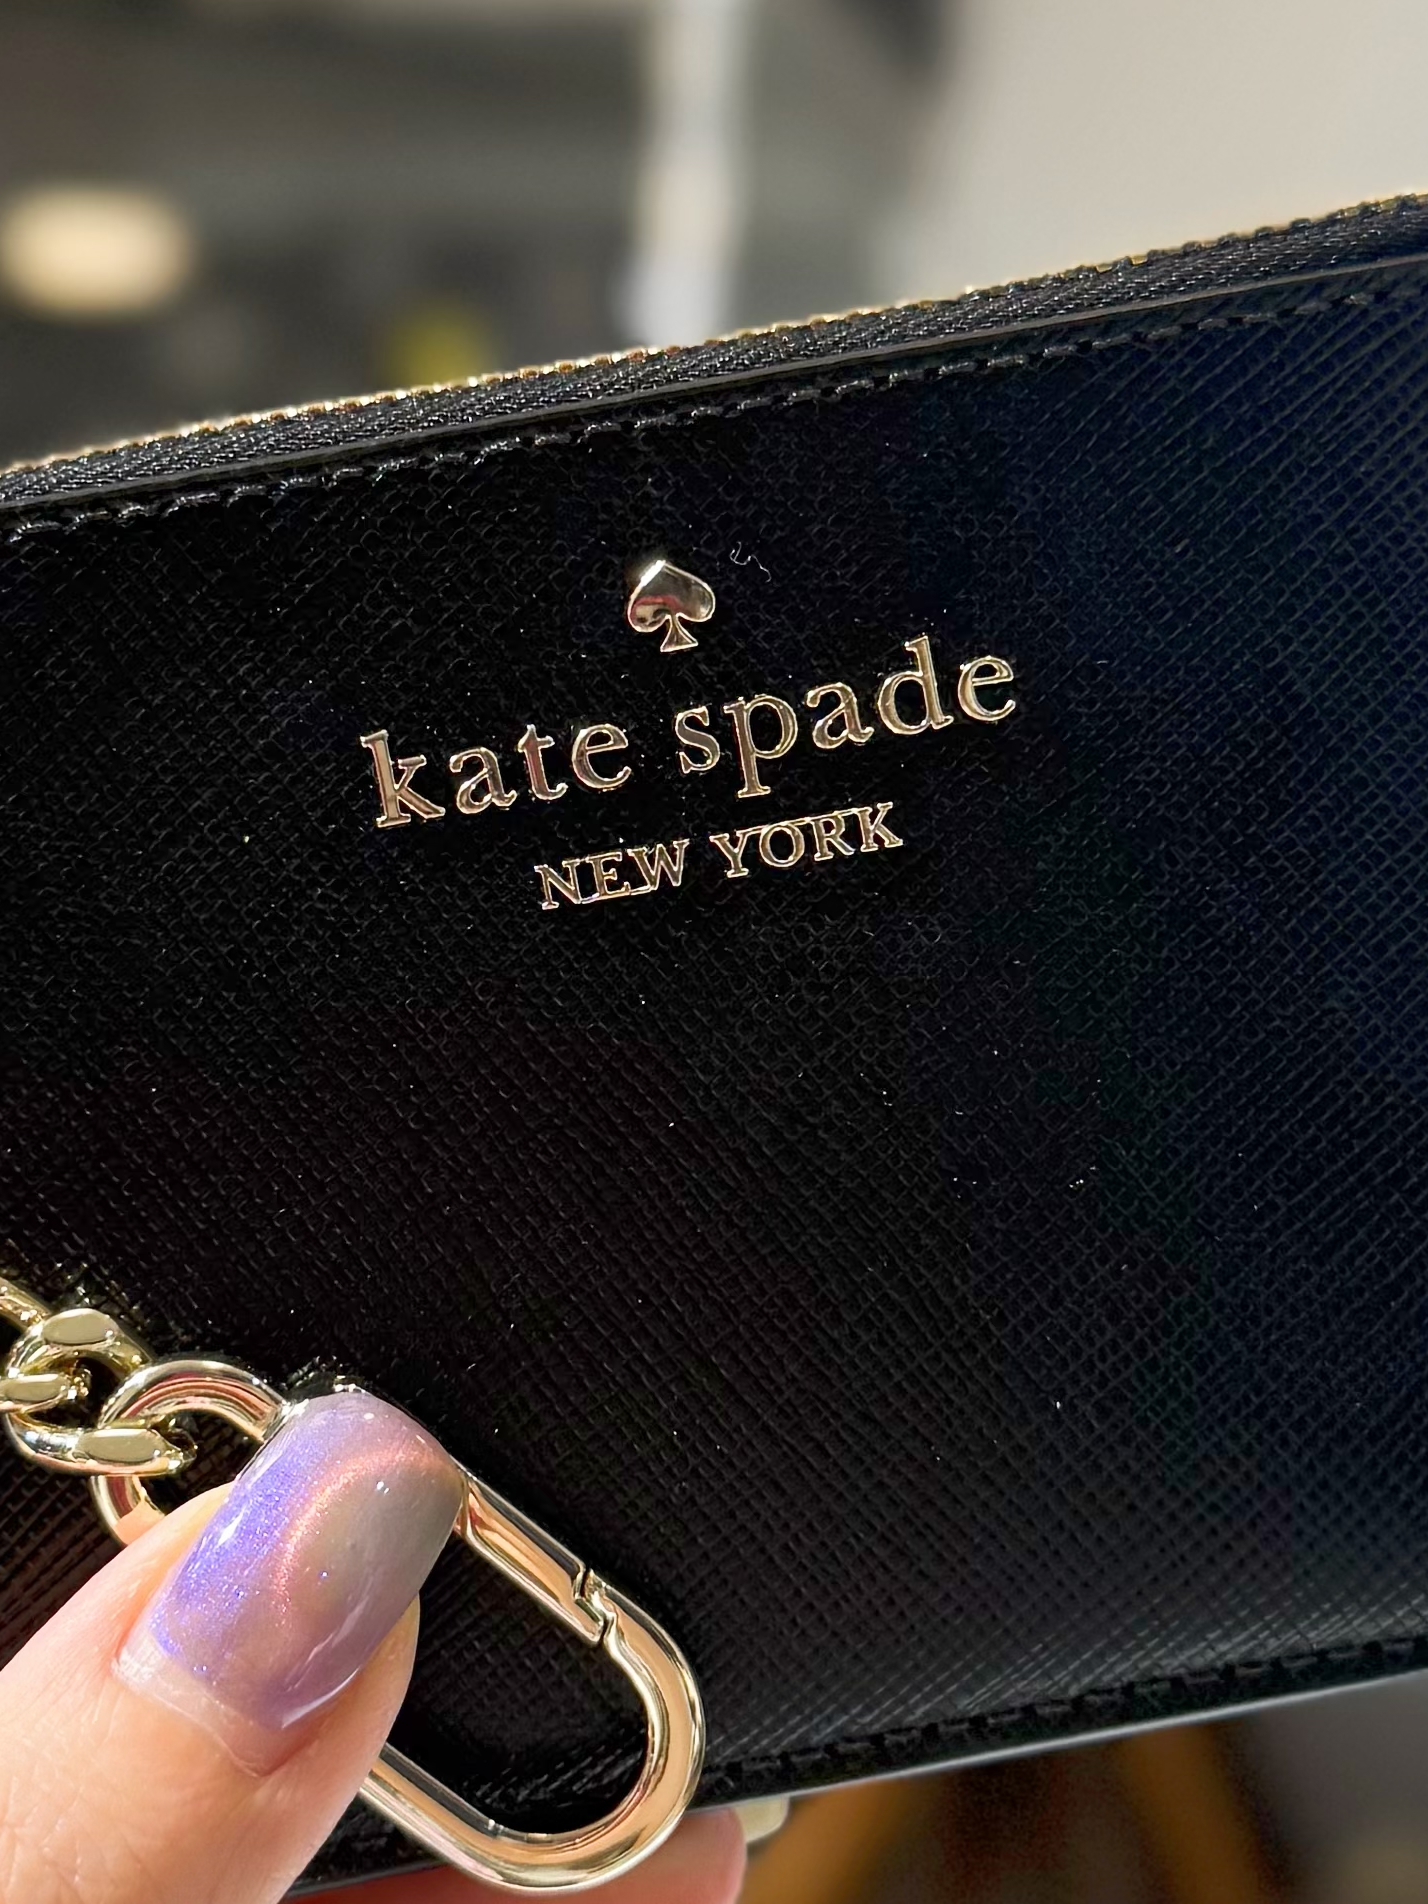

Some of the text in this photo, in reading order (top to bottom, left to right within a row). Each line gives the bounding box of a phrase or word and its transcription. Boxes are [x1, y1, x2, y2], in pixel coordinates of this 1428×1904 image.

[360, 634, 1017, 828] kate spade
[534, 800, 904, 910] NEW YORK
